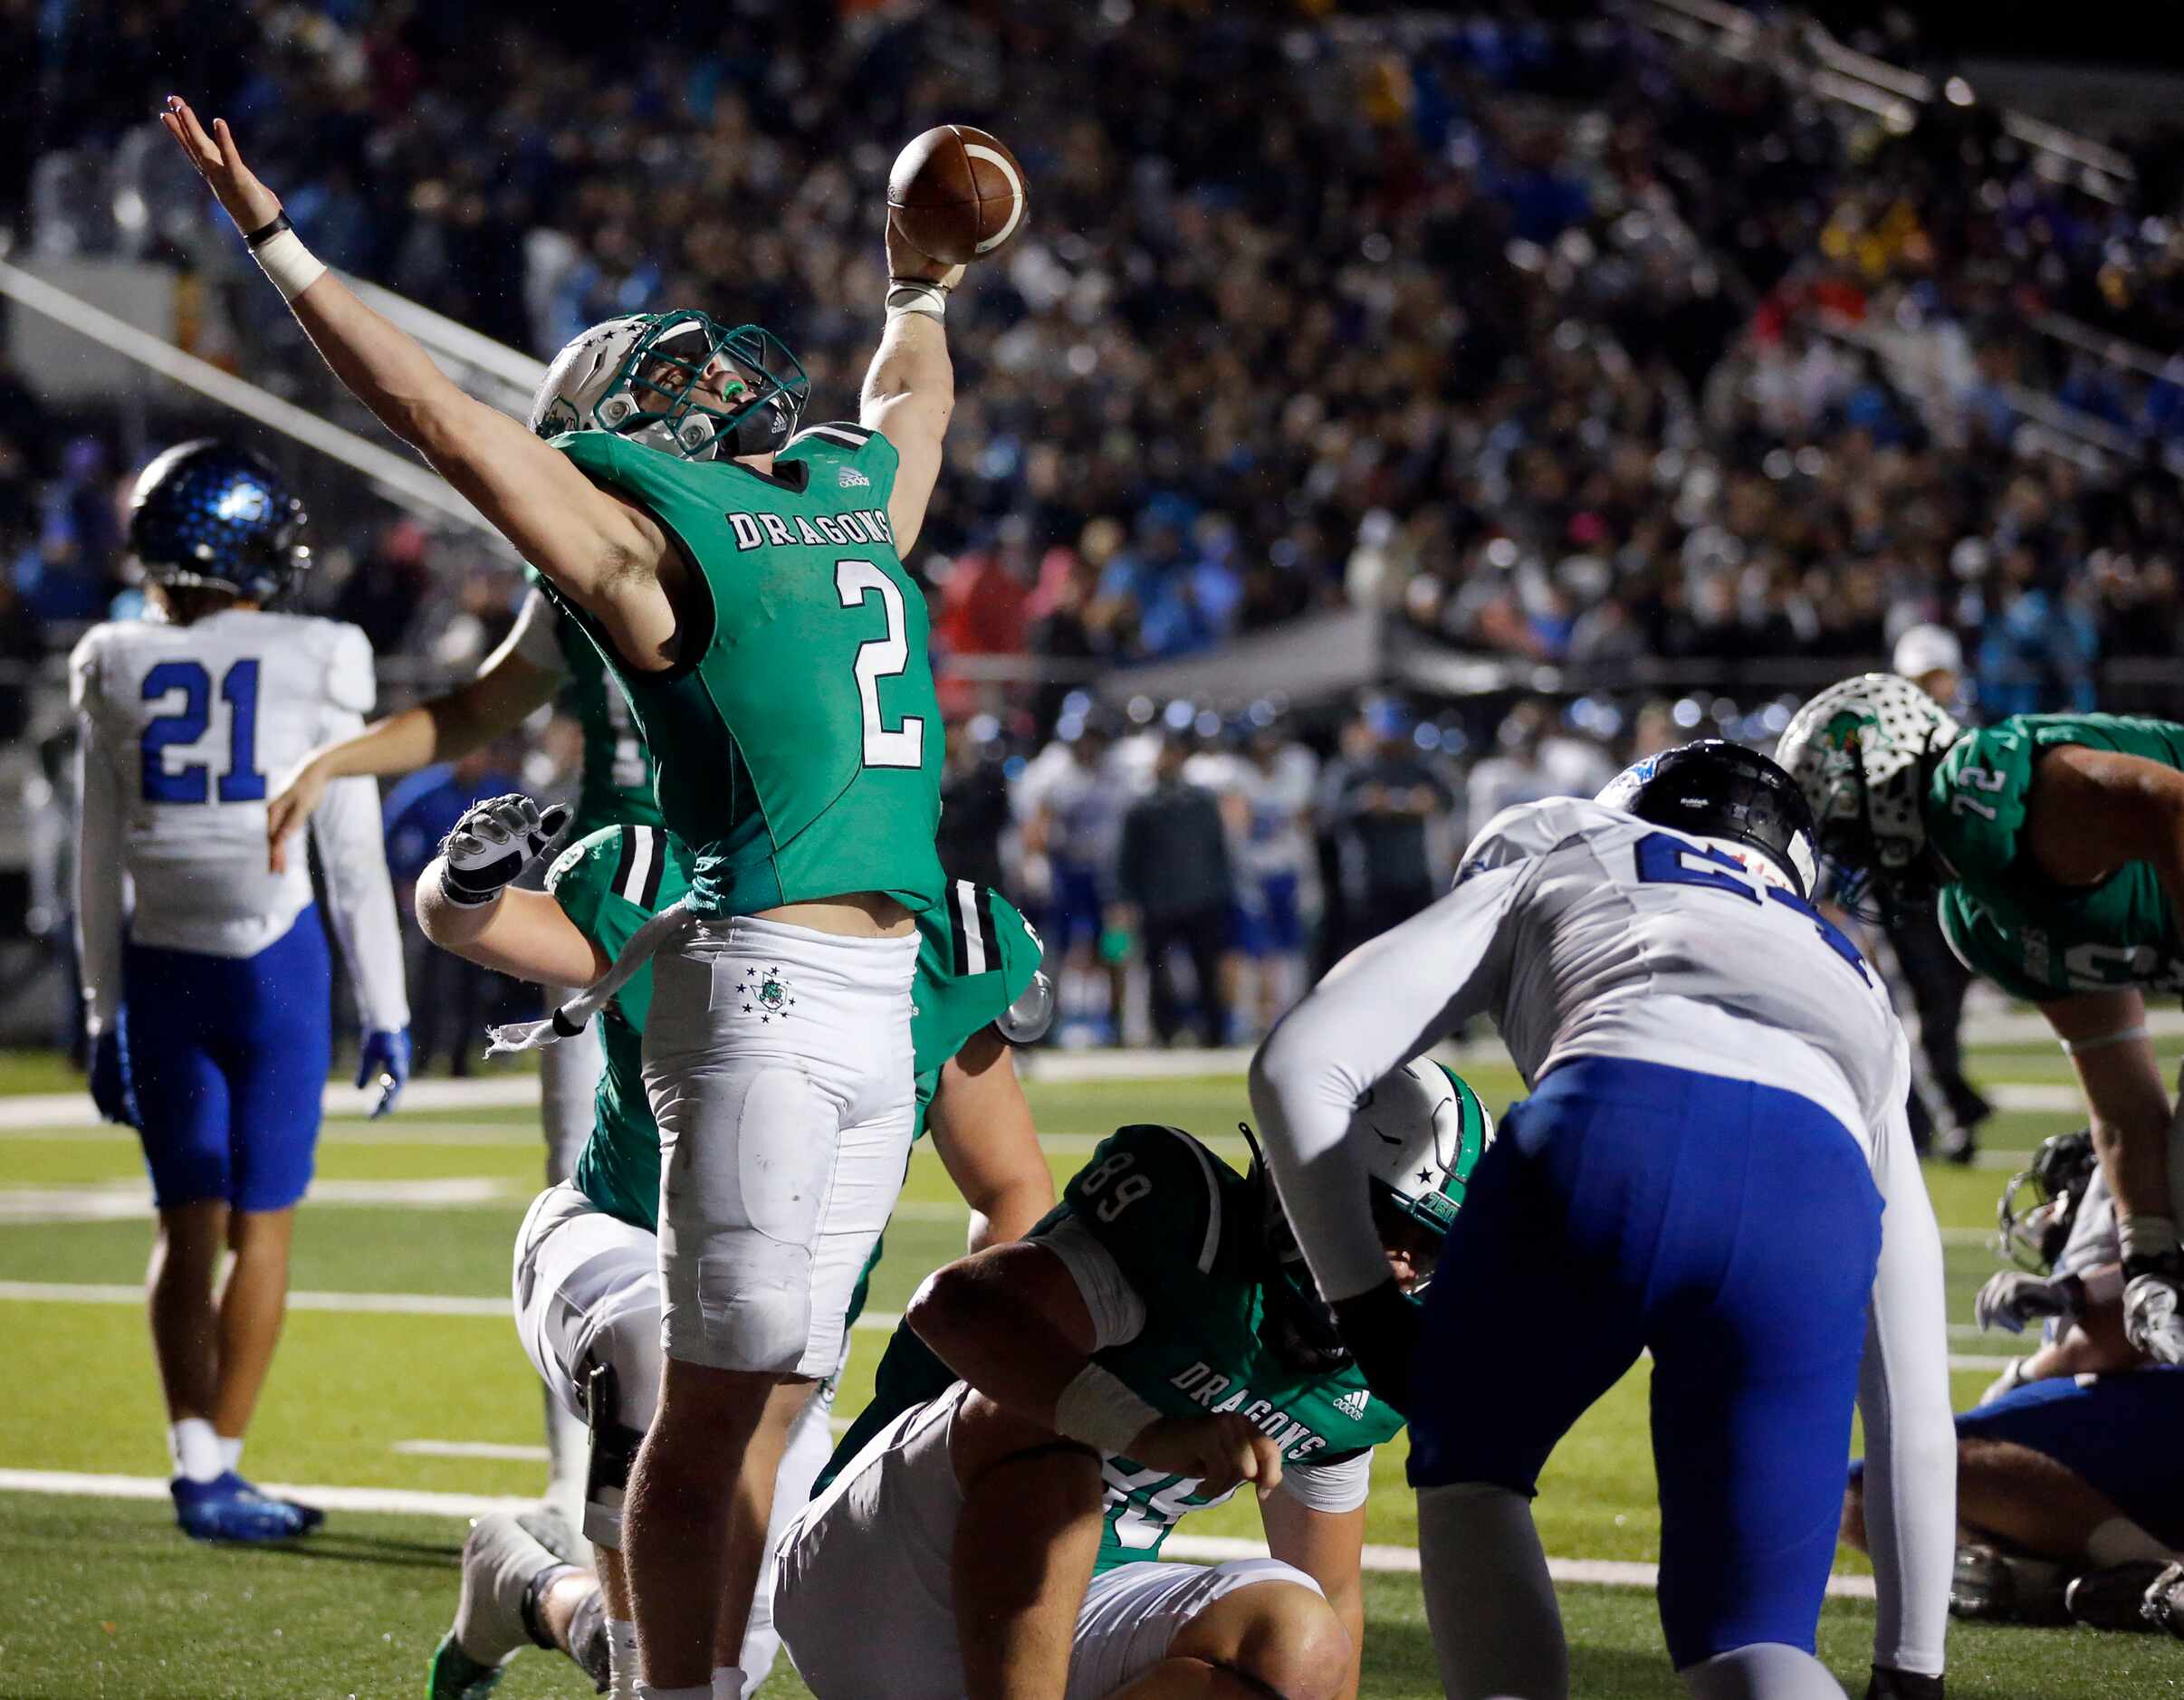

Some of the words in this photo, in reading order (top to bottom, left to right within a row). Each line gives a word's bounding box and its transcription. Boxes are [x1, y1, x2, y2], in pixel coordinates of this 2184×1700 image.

[726, 508, 893, 551] DRAGONS
[833, 559, 924, 769] 2
[140, 659, 266, 804] 21
[1951, 767, 2007, 820] 72
[1081, 1151, 1152, 1223] 89
[1170, 1361, 1327, 1460] DRAGONS
[1333, 1398, 1363, 1421] adidas
